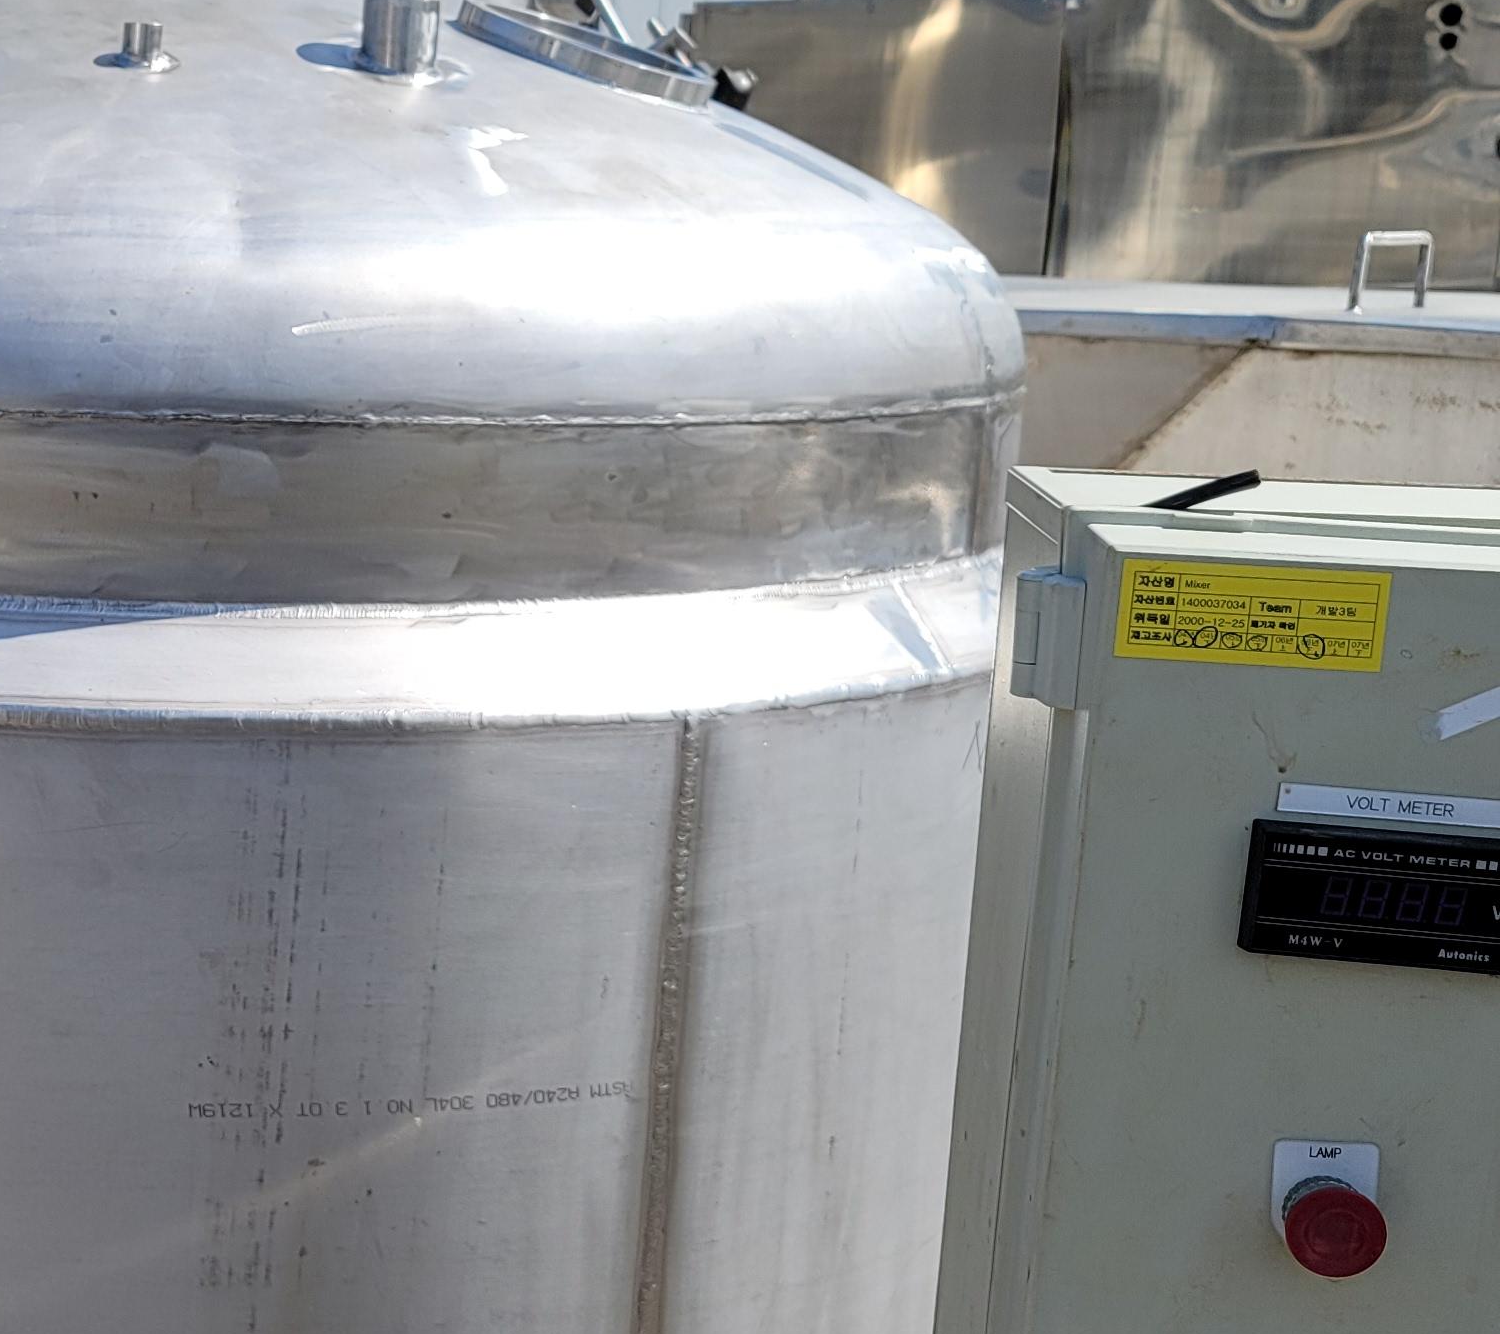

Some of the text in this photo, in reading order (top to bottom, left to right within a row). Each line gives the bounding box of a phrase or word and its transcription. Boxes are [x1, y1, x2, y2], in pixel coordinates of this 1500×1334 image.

[1138, 575, 1175, 588] 자산명
[1184, 579, 1211, 589] Mixer
[1134, 594, 1176, 606] 자산번호
[1181, 597, 1246, 610] 1400037034
[1258, 601, 1293, 614] Team
[1134, 612, 1171, 625] 취득일
[1177, 615, 1245, 628] 2000-12-25
[1347, 795, 1454, 818] VOLT METER
[1334, 849, 1471, 868] AC VOLT METER
[1438, 948, 1490, 963] Autonics
[590, 1080, 633, 1098] ASTM
[425, 1095, 474, 1112] 304L
[485, 1086, 580, 1109] A240/480
[188, 1102, 253, 1118] 1219W
[268, 1103, 283, 1118] X
[299, 1101, 348, 1117] 3.0T
[1308, 1146, 1342, 1159] LAMP
